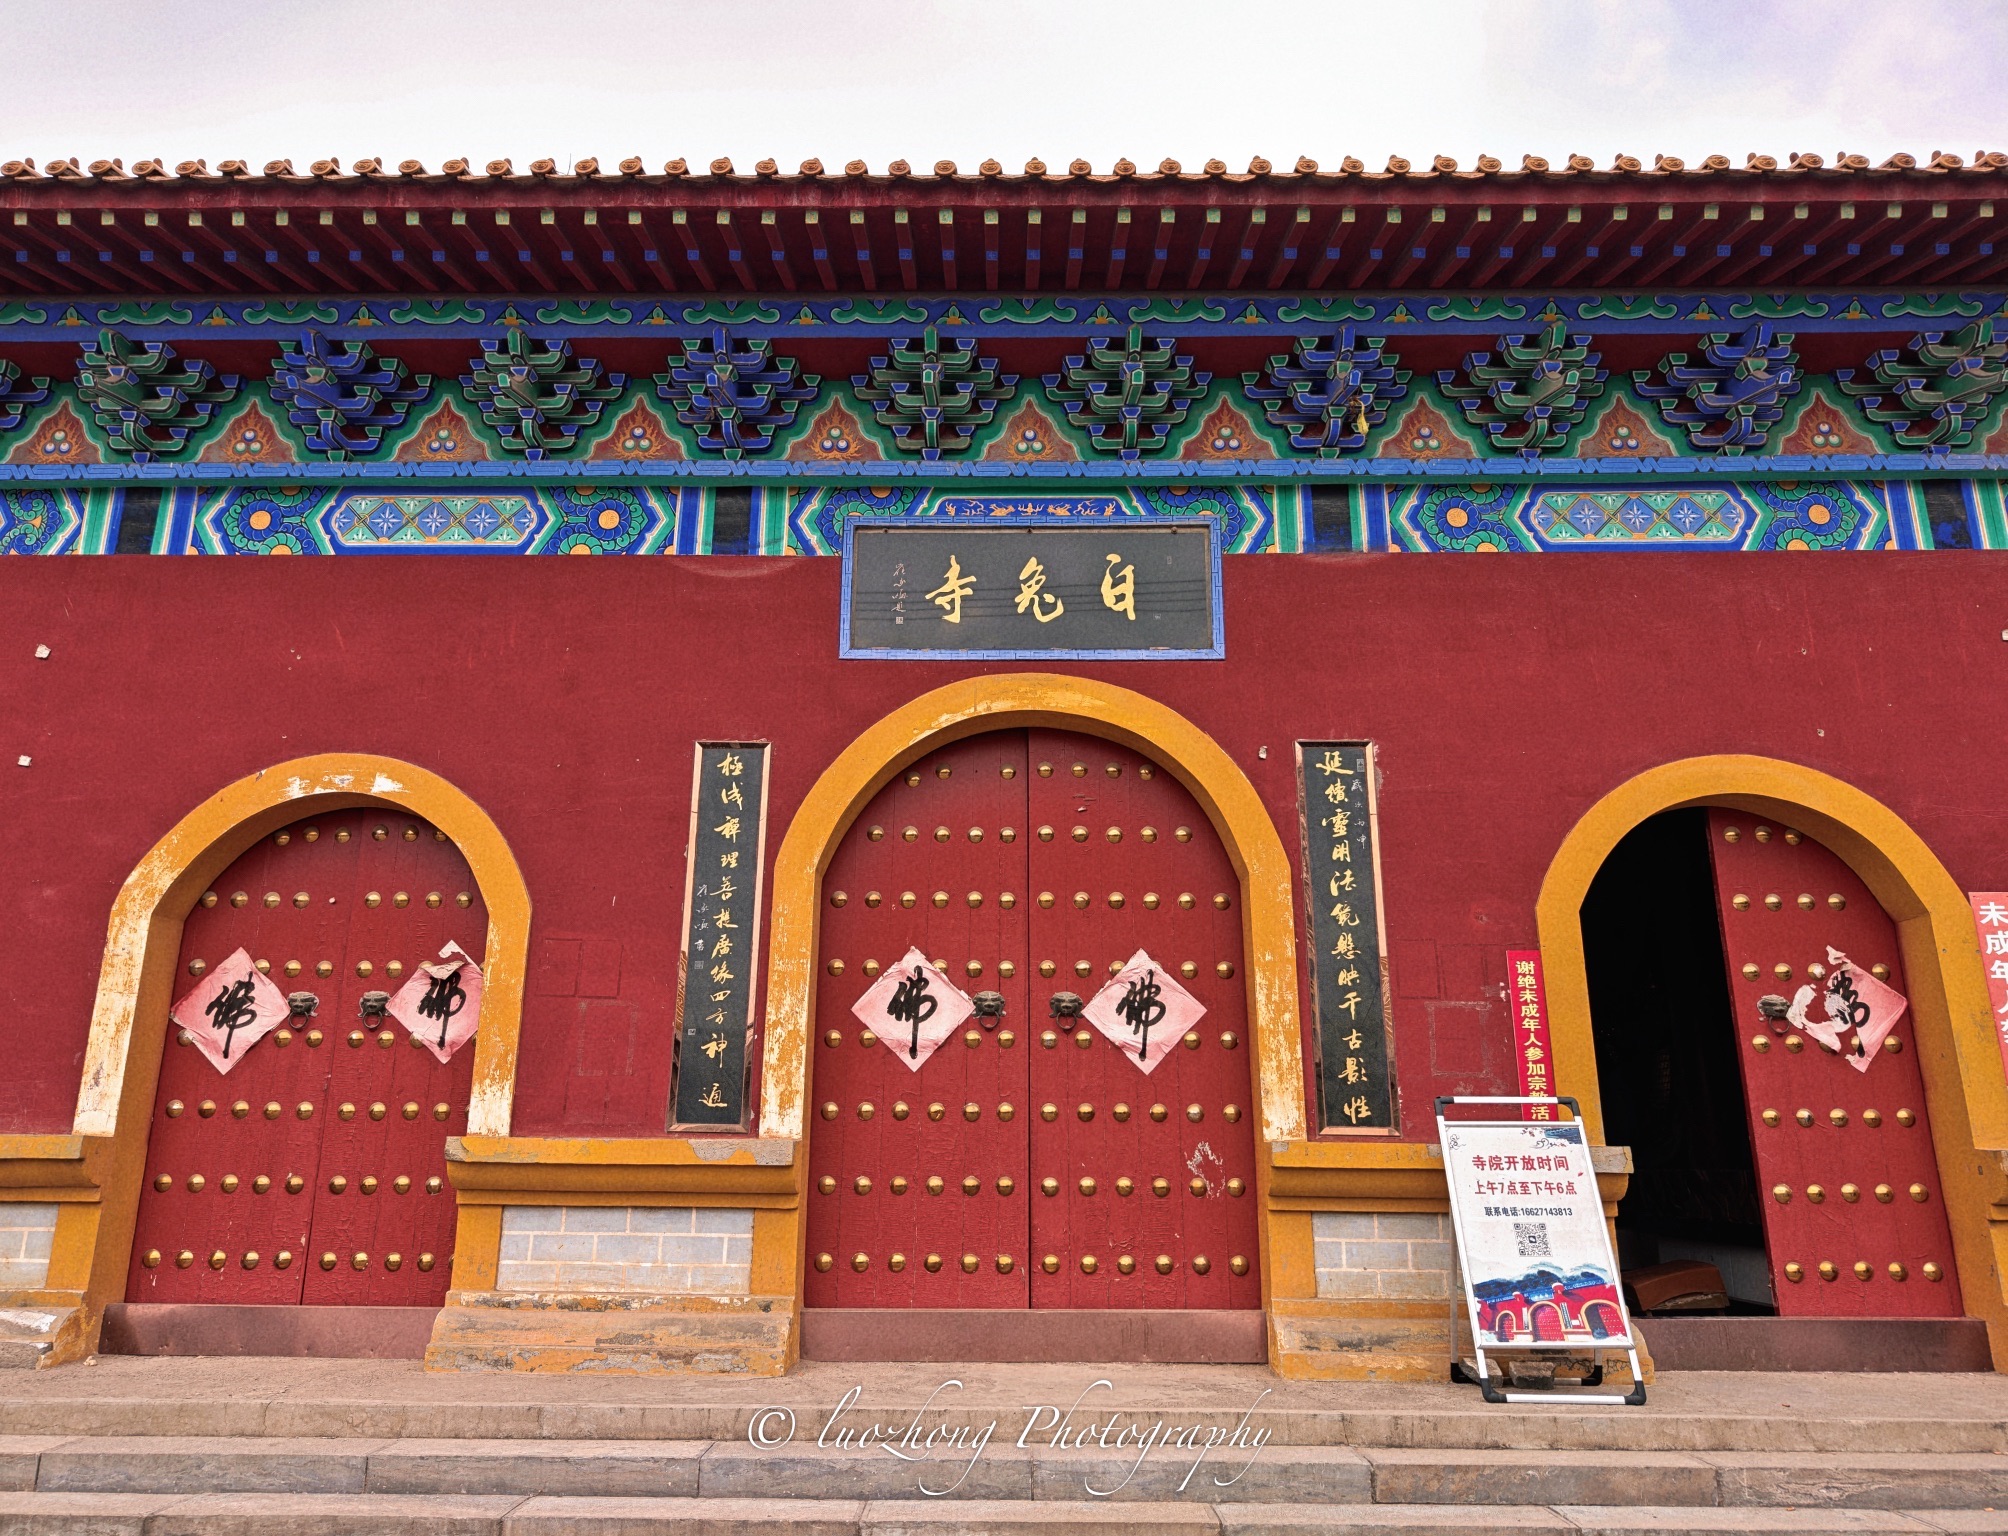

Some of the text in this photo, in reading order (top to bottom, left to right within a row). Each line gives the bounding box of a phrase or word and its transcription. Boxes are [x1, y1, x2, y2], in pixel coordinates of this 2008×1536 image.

[1472, 1155, 1570, 1171] 寺院开放时间
[1474, 1180, 1577, 1195] 上午7点至下午6点
